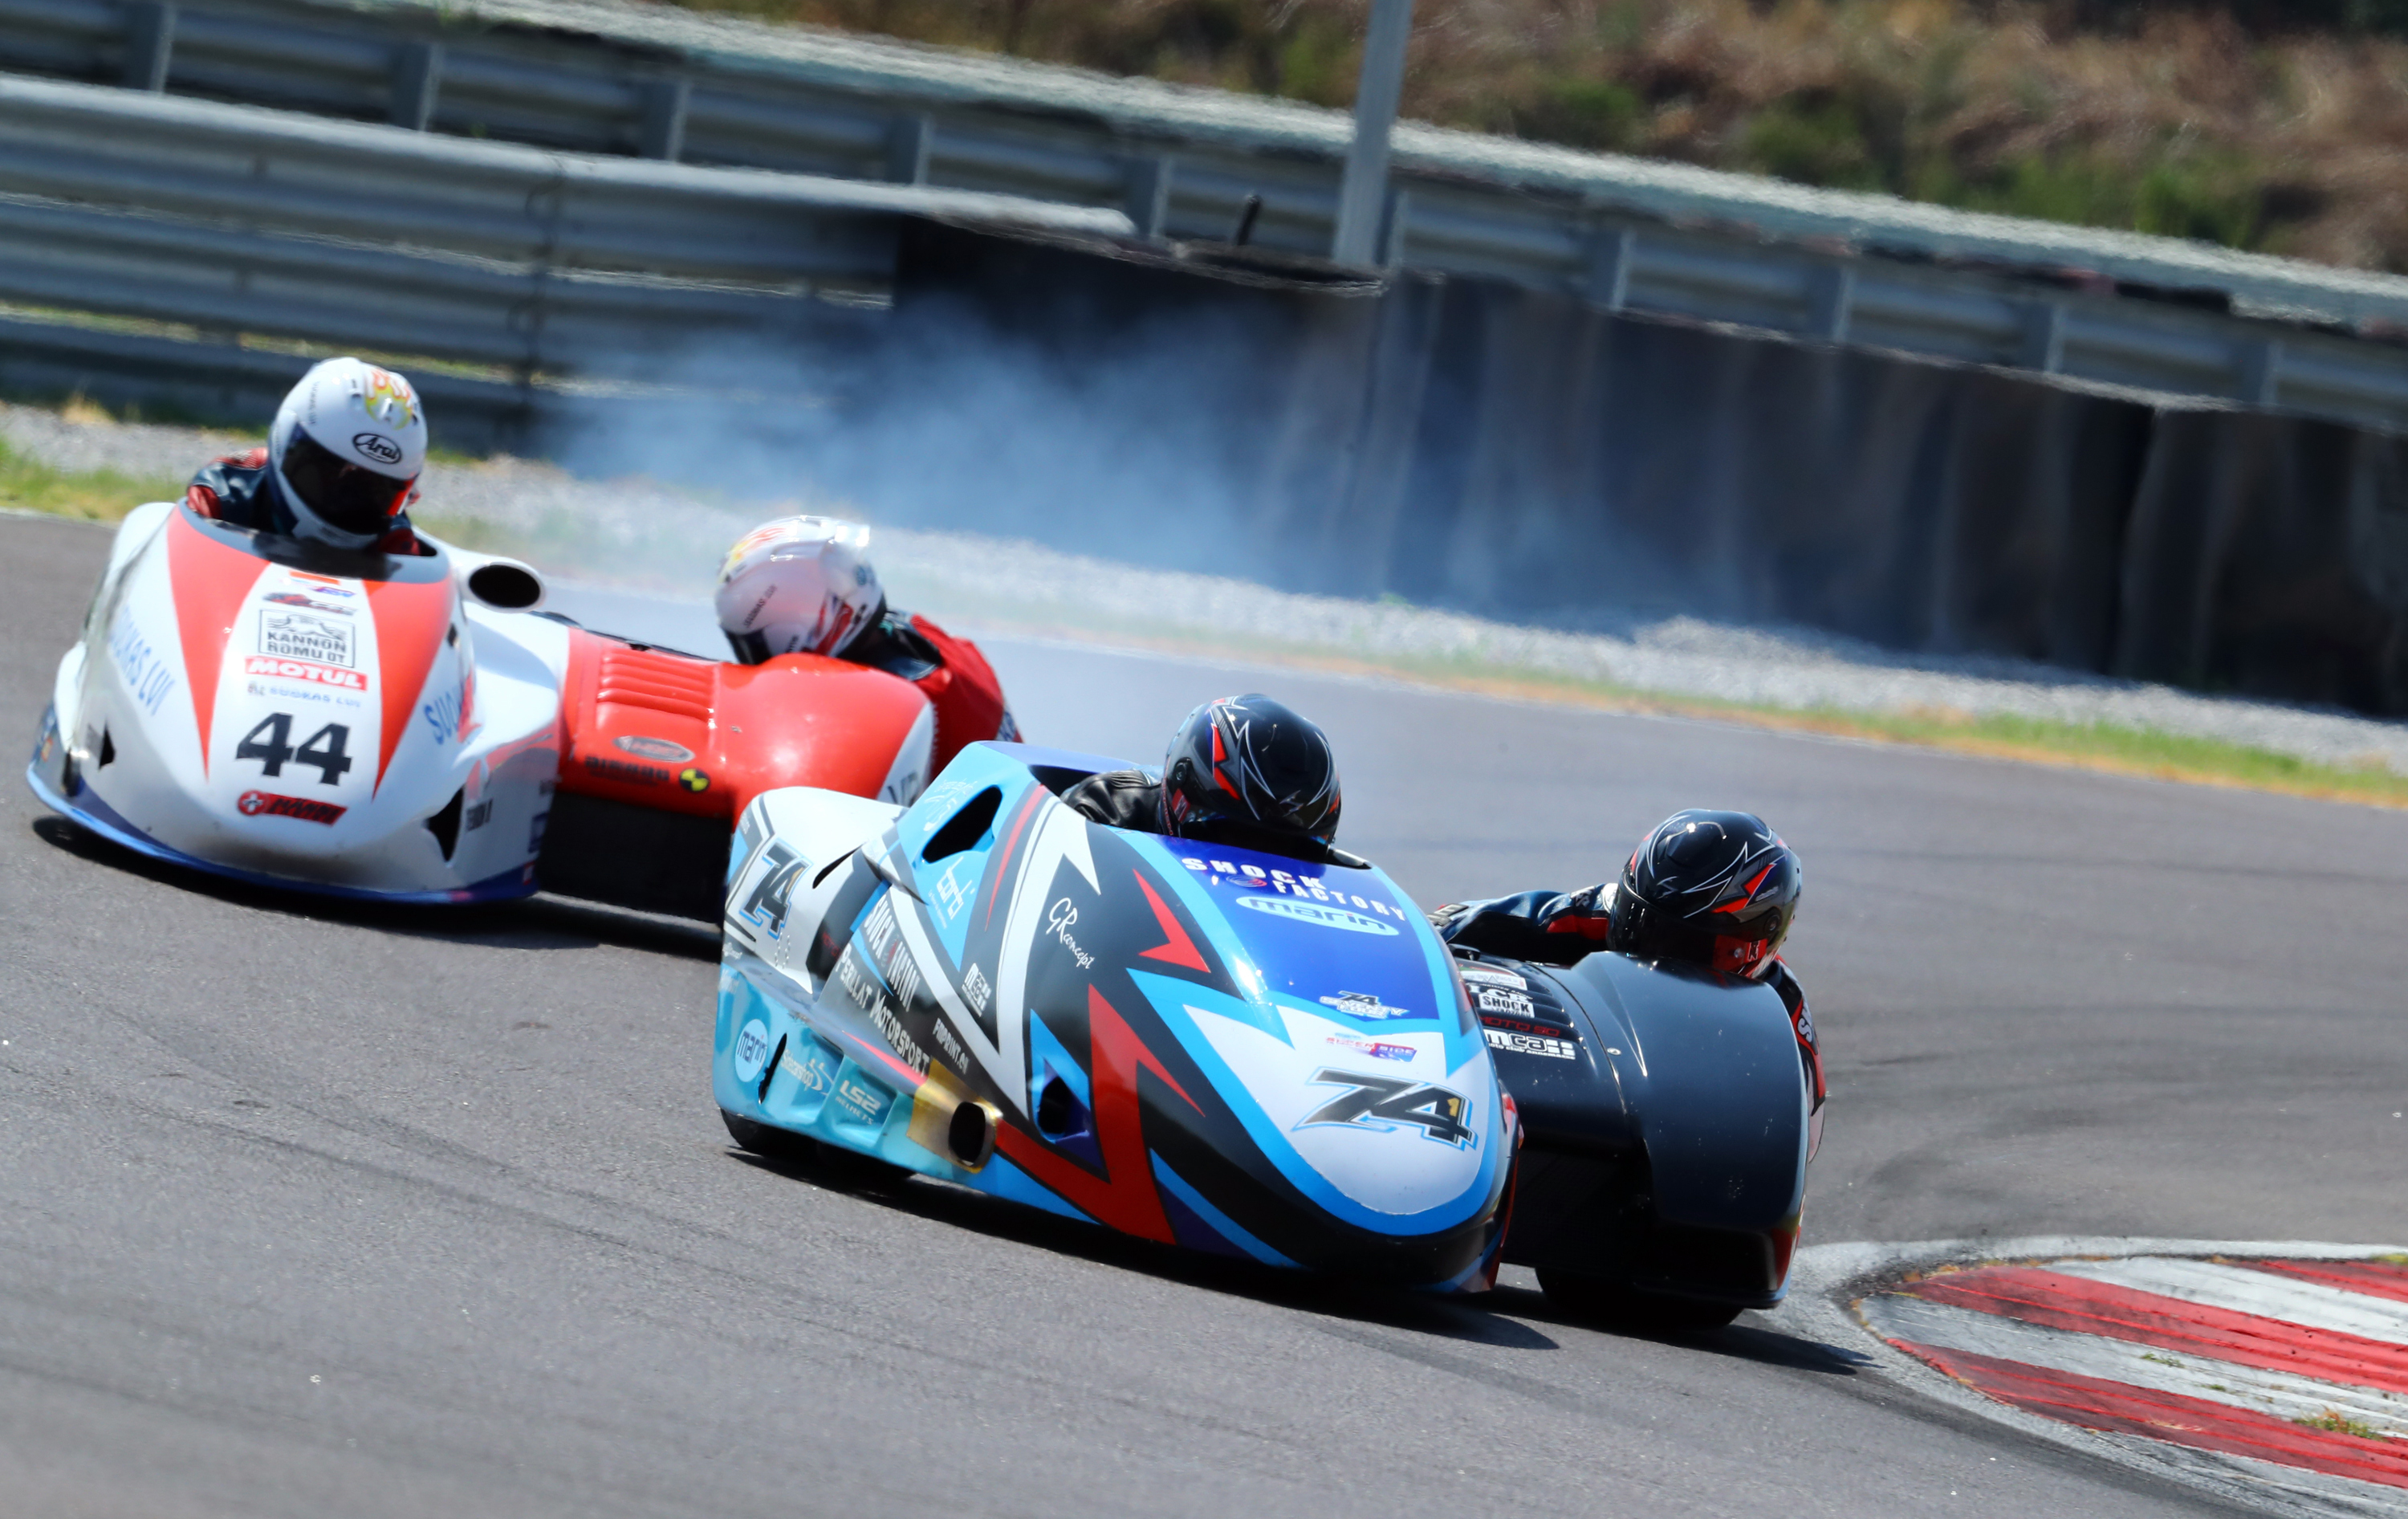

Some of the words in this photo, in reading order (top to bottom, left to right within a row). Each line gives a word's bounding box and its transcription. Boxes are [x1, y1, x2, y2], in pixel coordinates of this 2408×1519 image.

[364, 437, 398, 459] Arai
[267, 632, 347, 653] KANNON
[267, 642, 323, 659] ROMU
[248, 659, 362, 687] MOTUL
[236, 712, 352, 786] 44
[739, 837, 814, 940] 74
[1182, 857, 1327, 890] SHOCK
[1247, 898, 1388, 931] marin
[1272, 879, 1405, 922] FACTORY
[1483, 996, 1530, 1013] SHOCK
[737, 1030, 767, 1065] marin
[840, 1079, 881, 1116] LS2
[1294, 1067, 1478, 1150] 74
